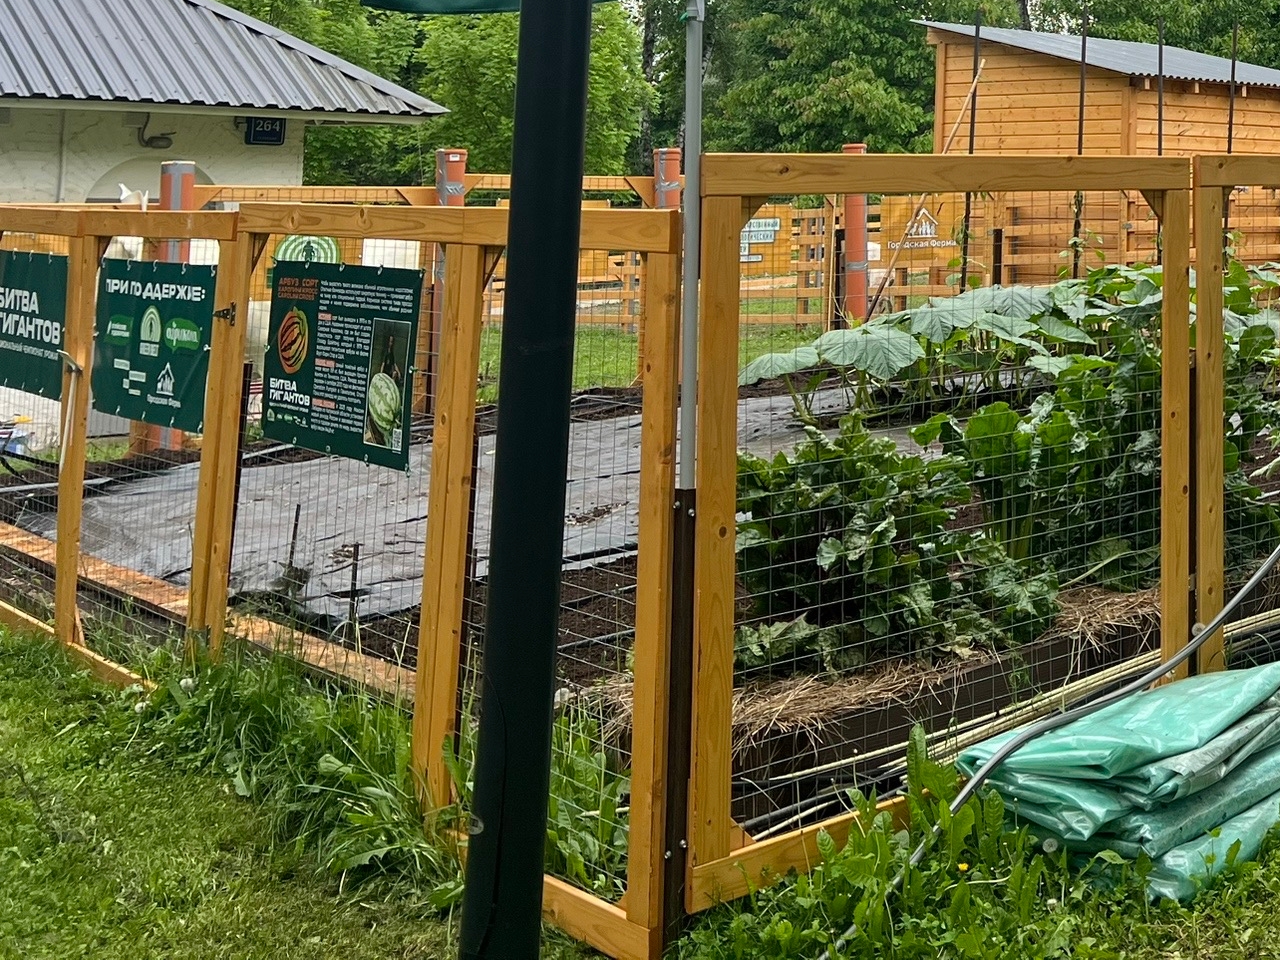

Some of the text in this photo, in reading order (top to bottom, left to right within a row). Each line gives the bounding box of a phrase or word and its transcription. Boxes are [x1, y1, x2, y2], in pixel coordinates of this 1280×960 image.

[256, 120, 280, 132] 264
[887, 240, 929, 249] Гордская
[105, 278, 129, 295] ПРИ
[278, 277, 319, 287] АРБУЗ СОРТ
[269, 377, 297, 392] БИТВА
[269, 389, 311, 406] ГИГАНТОВ
